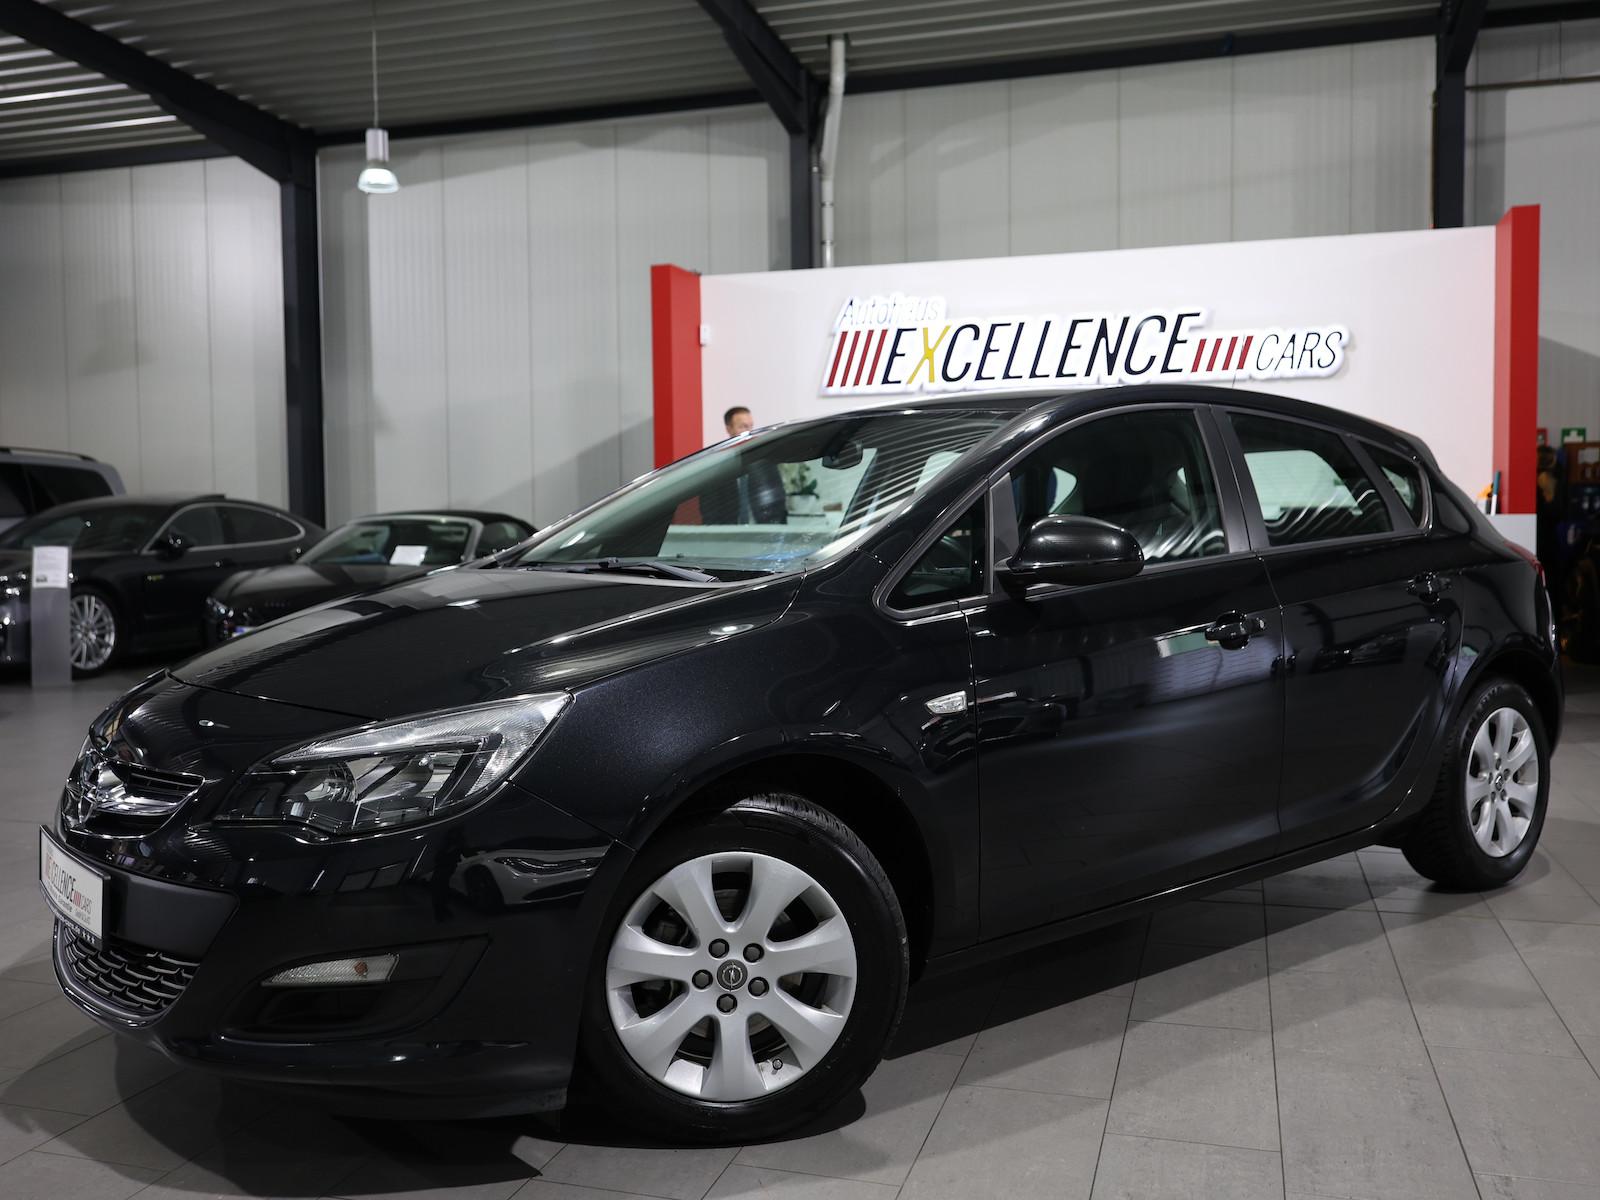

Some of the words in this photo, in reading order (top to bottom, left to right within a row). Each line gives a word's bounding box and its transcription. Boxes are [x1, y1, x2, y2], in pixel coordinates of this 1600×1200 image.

[838, 296, 940, 328] Autohaus
[881, 312, 1201, 385] EXCELLENCE
[1255, 331, 1343, 371] CARS
